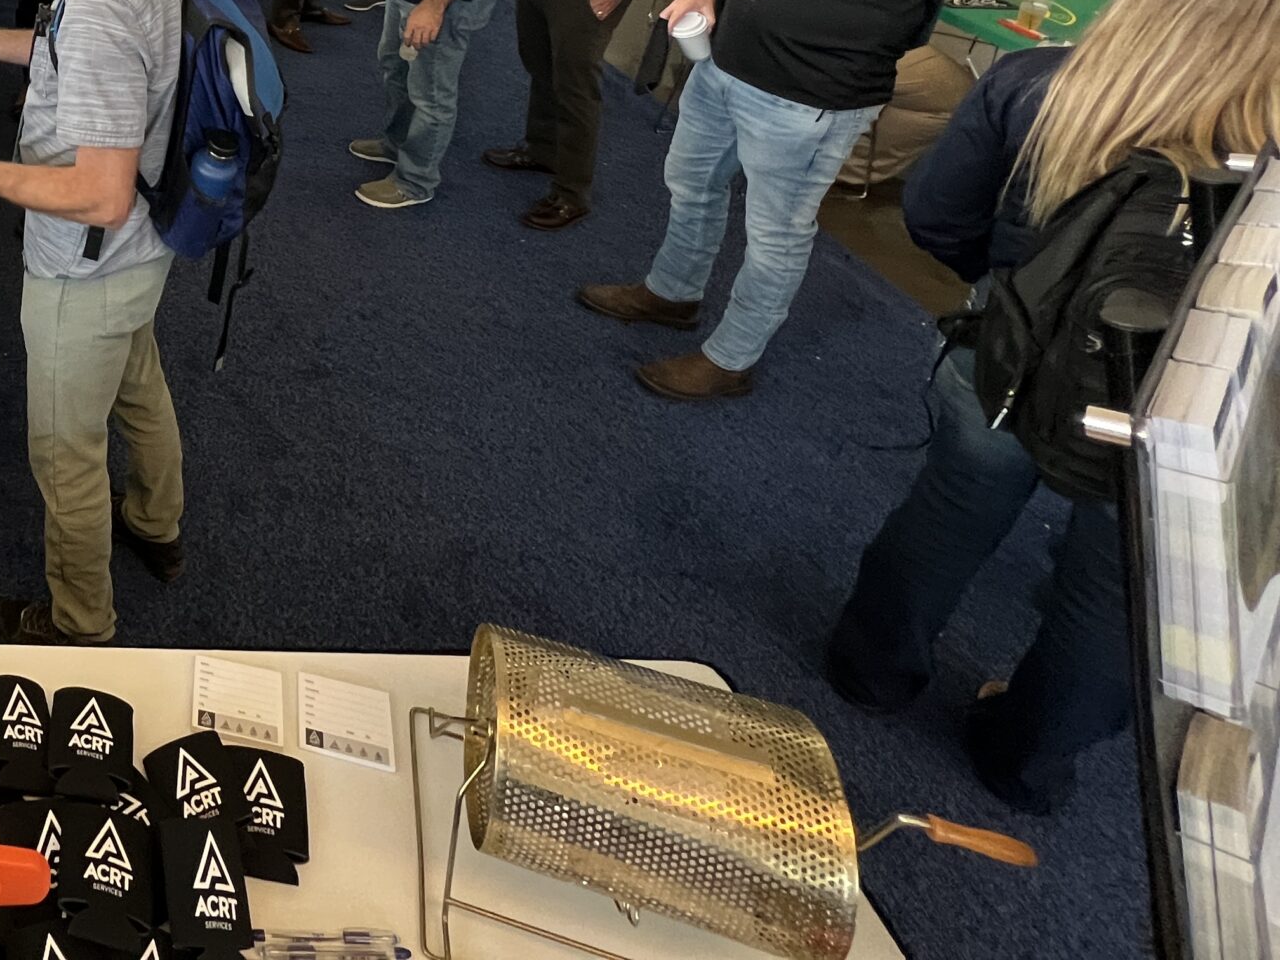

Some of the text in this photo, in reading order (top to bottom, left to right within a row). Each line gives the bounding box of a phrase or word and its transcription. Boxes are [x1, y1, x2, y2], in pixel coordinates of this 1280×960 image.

[3, 724, 44, 744] ACRT
[68, 732, 114, 755] ACRT
[12, 741, 38, 751] SERVICES
[76, 749, 104, 760] SERVICES
[183, 786, 222, 819] ACRT
[251, 806, 285, 829] CRT
[247, 825, 275, 836] SERVICES
[83, 862, 134, 891] ACRT
[92, 882, 123, 898] SERVICES
[194, 895, 238, 921] ACRT
[205, 920, 233, 931] SERVICES
